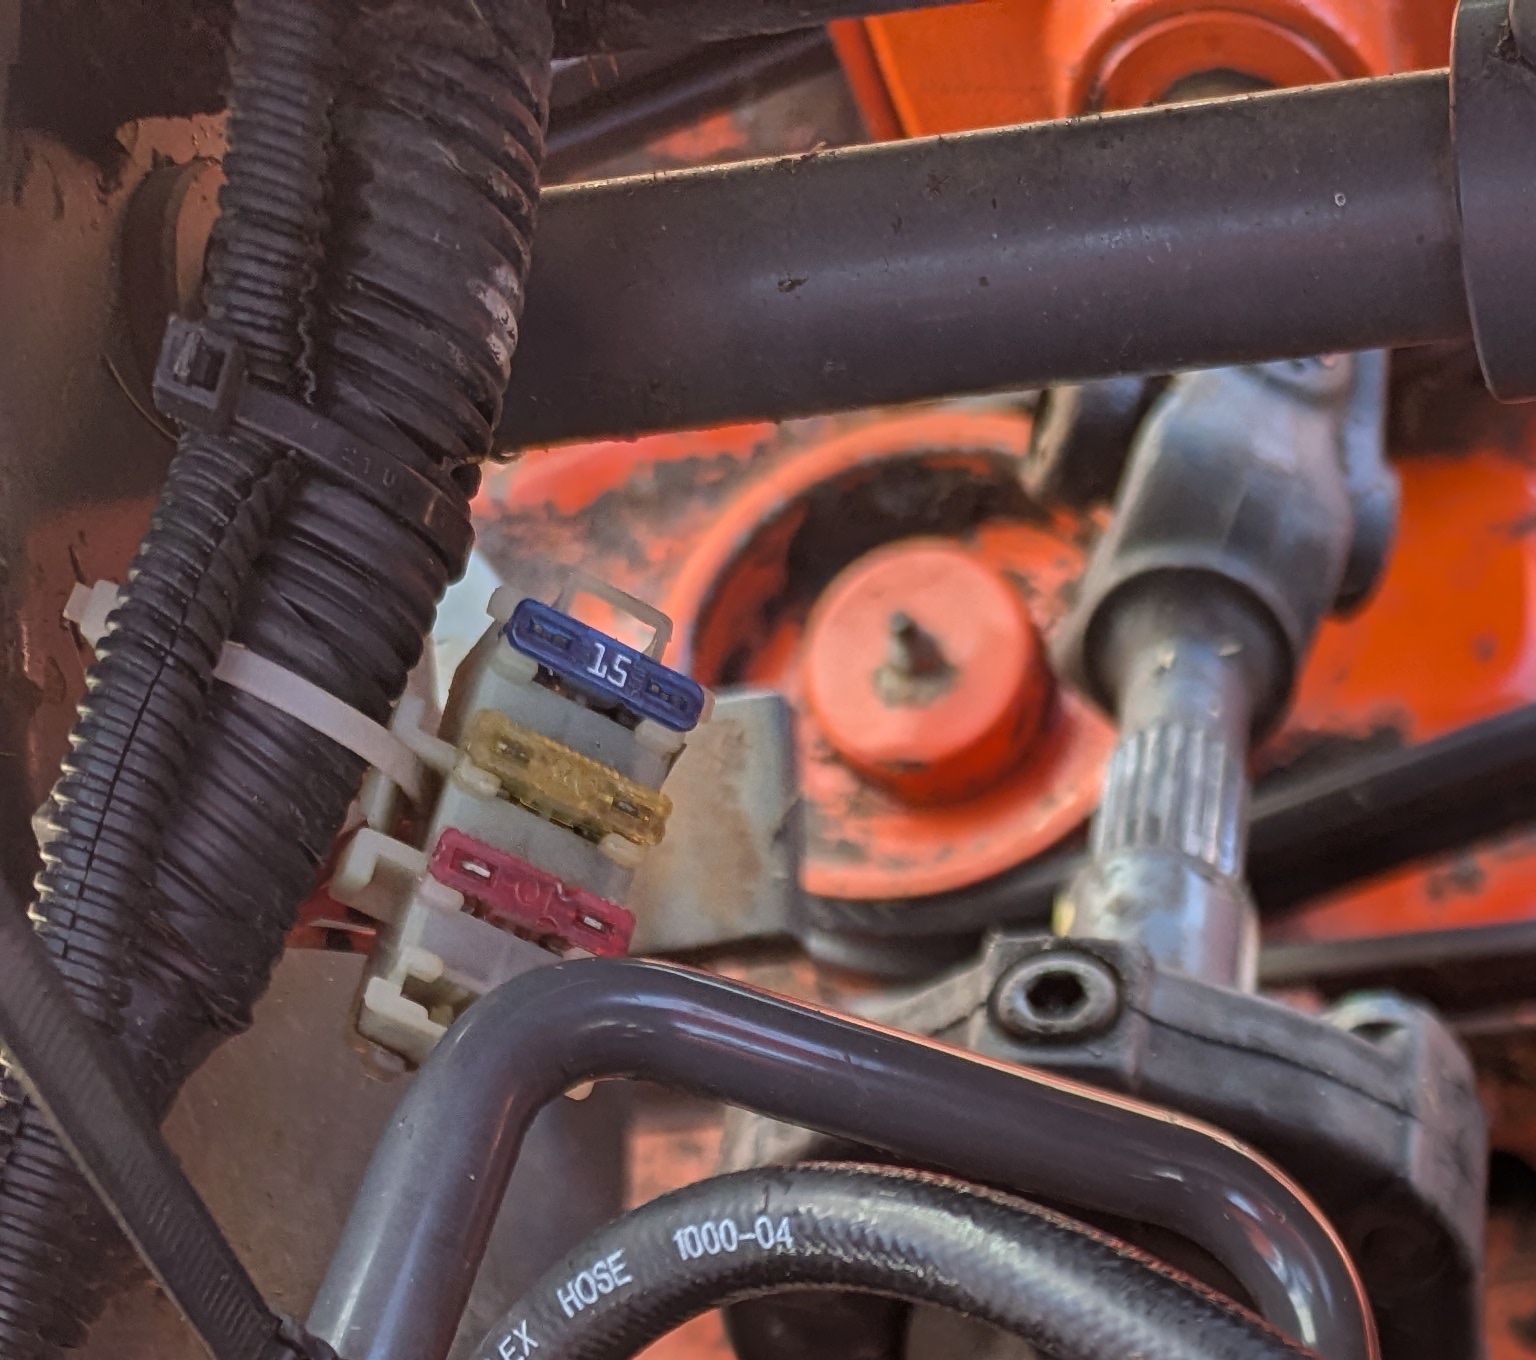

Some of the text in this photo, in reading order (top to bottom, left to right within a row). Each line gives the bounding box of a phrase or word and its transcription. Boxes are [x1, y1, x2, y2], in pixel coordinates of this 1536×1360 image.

[587, 642, 632, 688] 15
[556, 1249, 633, 1318] HOSE
[672, 1215, 794, 1261] 1000-04
